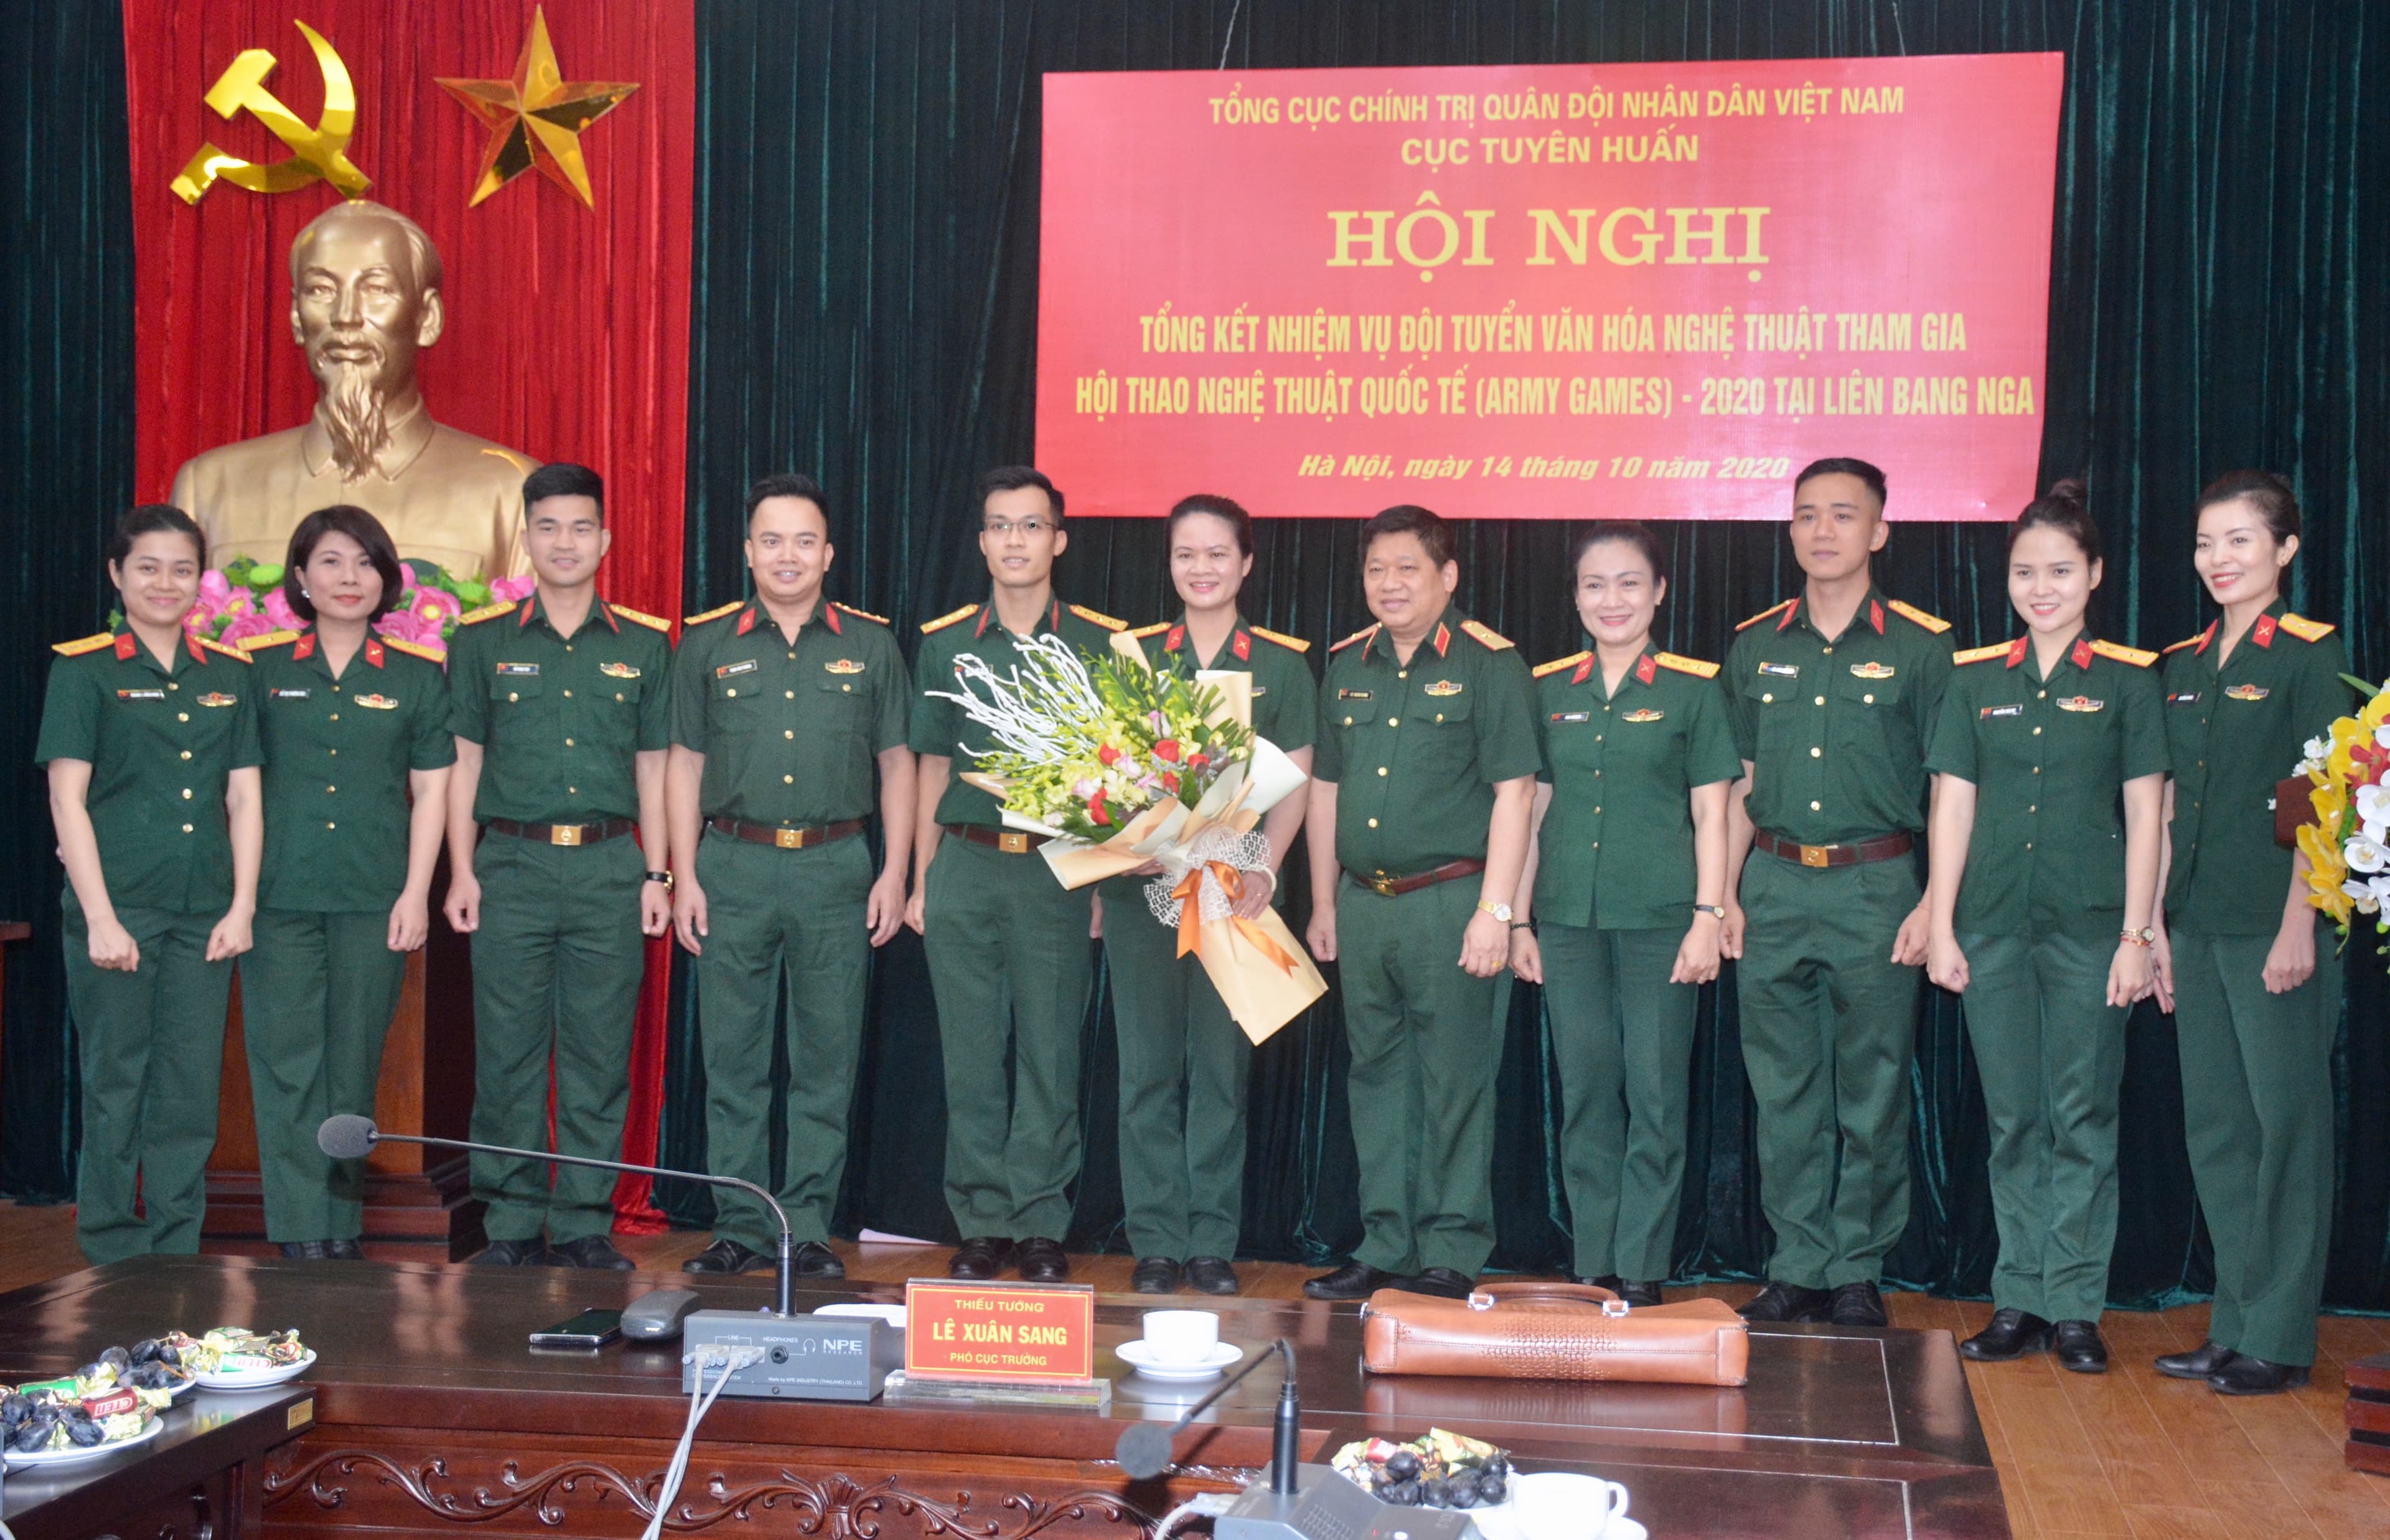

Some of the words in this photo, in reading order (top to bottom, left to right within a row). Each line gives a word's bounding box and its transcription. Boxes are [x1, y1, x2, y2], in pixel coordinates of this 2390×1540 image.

[1209, 82, 1280, 124] TỔNG
[1288, 96, 1341, 131] CỤC
[1349, 88, 1428, 123] CHÍNH
[1436, 95, 1475, 128] TRỊ
[1484, 86, 1560, 121] QUÂN
[1567, 85, 1614, 126] ĐỘI
[1622, 83, 1699, 118] NHÂN
[1707, 82, 1766, 116] DÂN
[1774, 81, 1833, 123] VIỆT
[1840, 86, 1905, 114] NAM
[1401, 138, 1469, 173] CỤC
[1480, 129, 1591, 164] TUYÊN
[1601, 123, 1699, 163] HUẤN
[1326, 190, 1496, 283] HỘI
[1526, 205, 1770, 282] NGHỊ
[1140, 301, 1206, 353] TỔNG
[1214, 302, 1260, 353] KẾT
[1267, 307, 1351, 361] NHIỆM
[1359, 315, 1392, 361] VỤ
[1399, 307, 1443, 361] ĐỘI
[1451, 299, 1533, 352] TUYỂN
[1542, 307, 1593, 352] VĂN
[1603, 306, 1655, 352] HÓA
[1664, 306, 1735, 360] NGHỆ
[1743, 305, 1827, 360] THUẬT
[1835, 313, 1911, 352] THAM
[1921, 312, 1967, 351] GIA
[1076, 369, 1118, 422] HỘI
[1125, 376, 1190, 414] THAO
[1197, 369, 1265, 422] NGHỆ
[1273, 369, 1353, 422] THUẬT
[1361, 363, 1430, 419] QUỐC
[1437, 363, 1469, 414] TẾ
[1476, 377, 1561, 418] (ARMY
[1568, 377, 1672, 419] GAMES)
[1682, 394, 1692, 403] -
[1700, 376, 1766, 416] 2020
[1773, 376, 1815, 424] TẠI
[1824, 368, 1883, 416] LIÊN
[1892, 376, 1967, 415] BANG
[1977, 376, 2035, 415] NGA
[1298, 454, 1336, 477] Hà
[1341, 455, 1395, 481] Nội,
[1404, 457, 1473, 480] ngày
[1481, 456, 1512, 477] 14
[1520, 456, 1600, 480] tháng
[1610, 457, 1643, 478] 10
[1647, 456, 1710, 479] năm
[1715, 457, 1790, 479] 2020
[954, 1297, 994, 1310] THIẾU
[998, 1299, 1044, 1312] TƯỚNG
[823, 1338, 863, 1351] NPE
[933, 1318, 955, 1341] LÊ
[963, 1320, 1012, 1343] XUÂN
[1018, 1325, 1067, 1345] SANG
[950, 1351, 973, 1363] PHÓ
[975, 1353, 998, 1365] CỤC
